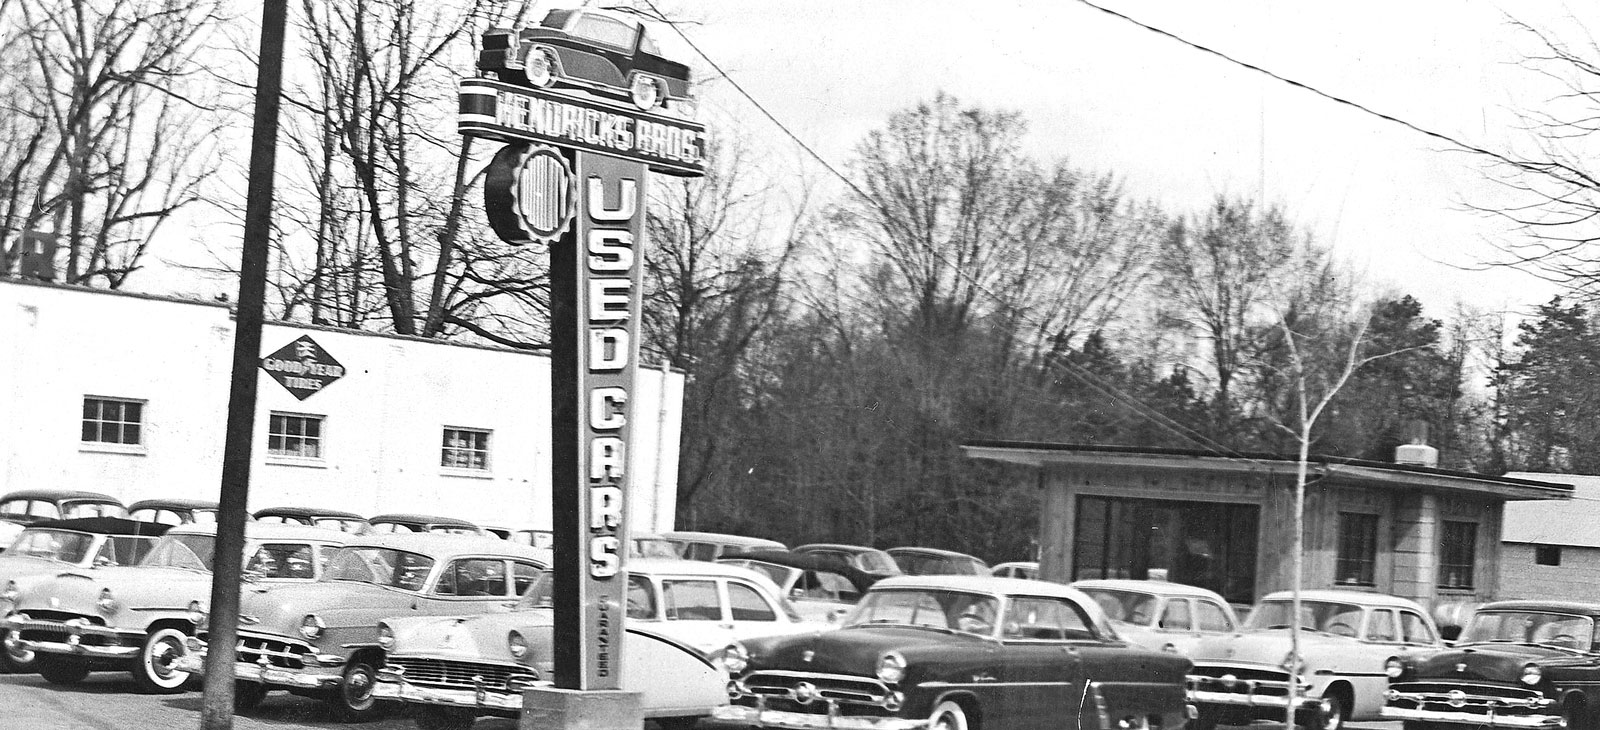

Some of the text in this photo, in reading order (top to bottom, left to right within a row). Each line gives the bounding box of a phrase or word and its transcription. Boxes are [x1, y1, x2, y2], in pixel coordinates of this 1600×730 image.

[496, 91, 634, 150] HENDRICKS
[284, 375, 323, 391] TIRES
[587, 177, 637, 577] USED CARS
[597, 594, 610, 678] GUARANTEED
